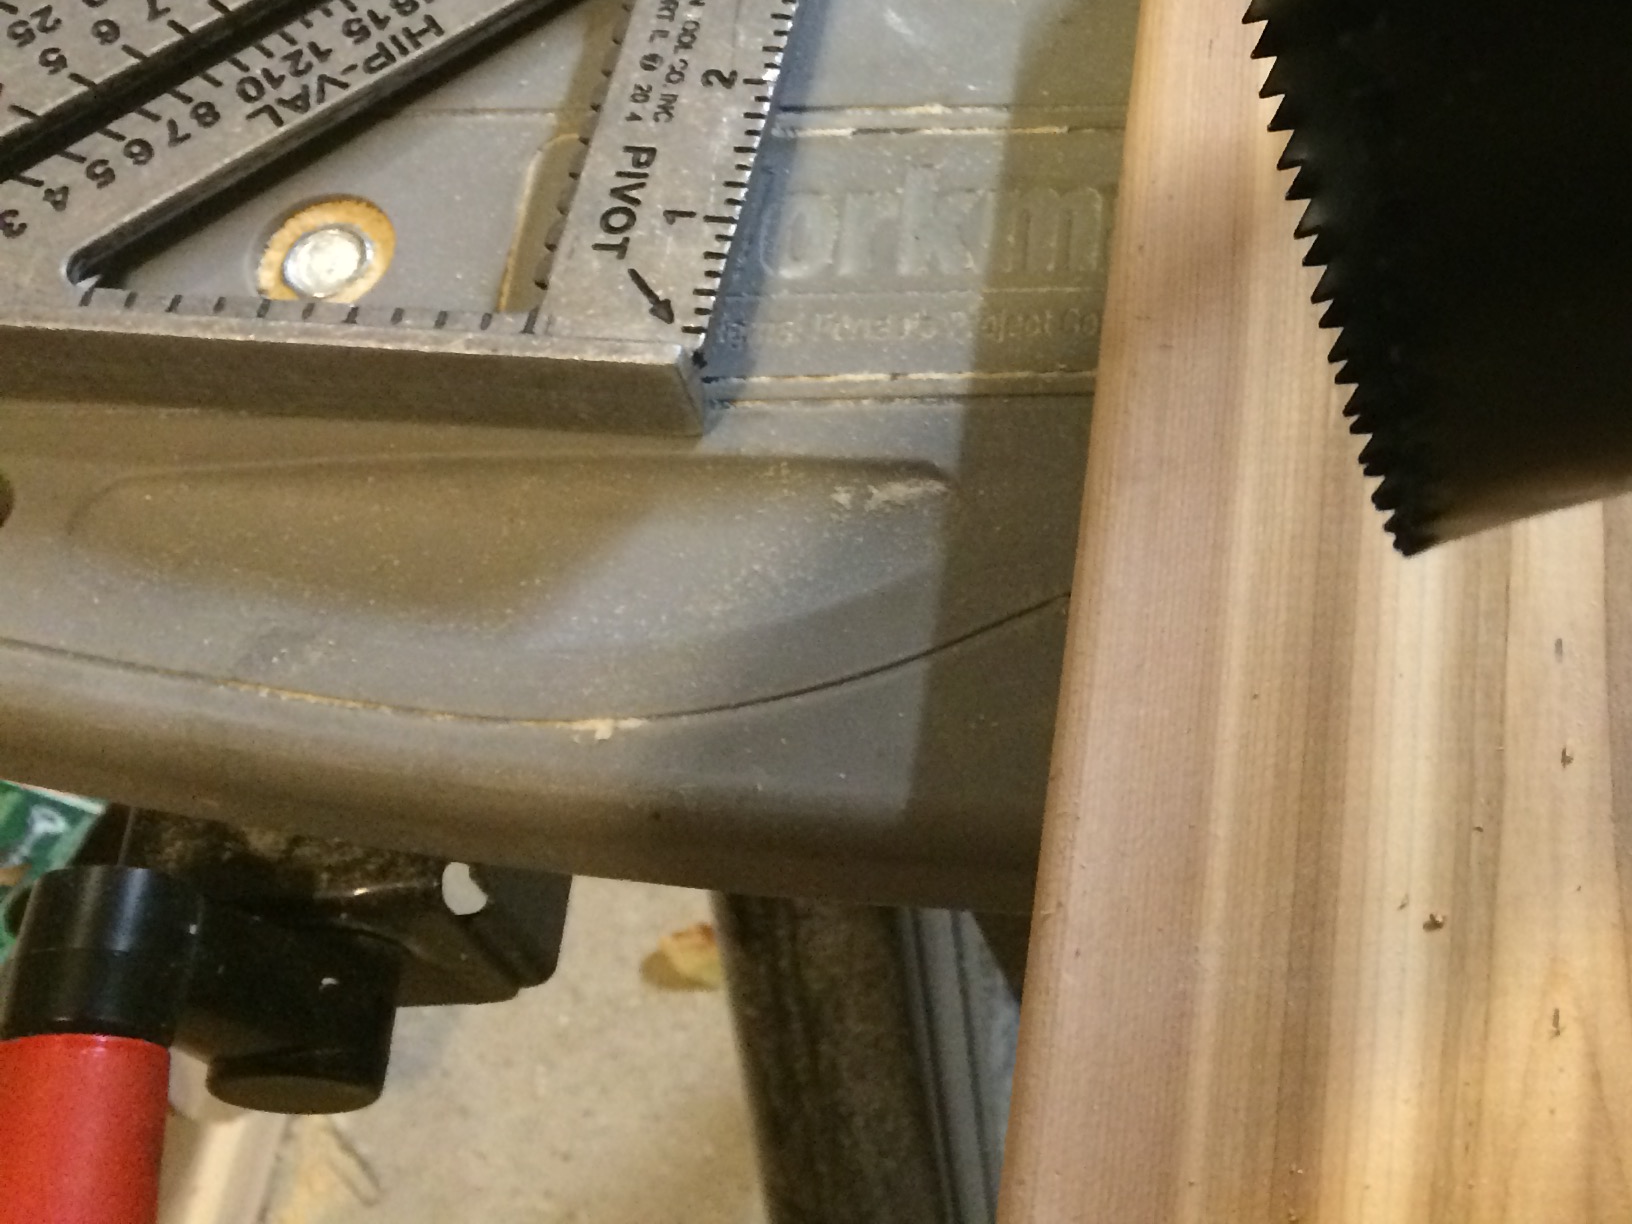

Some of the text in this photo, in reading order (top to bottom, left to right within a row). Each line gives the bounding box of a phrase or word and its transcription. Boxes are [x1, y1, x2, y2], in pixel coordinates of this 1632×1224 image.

[7, 4, 62, 47] 25
[91, 18, 120, 46] 6
[341, 8, 392, 45] 15
[38, 47, 68, 75] 5
[245, 13, 446, 128] HIP-VAL
[700, 68, 739, 90] 2
[189, 101, 221, 128] 8
[166, 118, 192, 147] 7
[123, 138, 155, 166] 6
[85, 158, 116, 189] 5
[42, 185, 70, 212] 4
[591, 145, 657, 261] PIVOT
[0, 208, 28, 239] 3
[662, 209, 697, 225] 1
